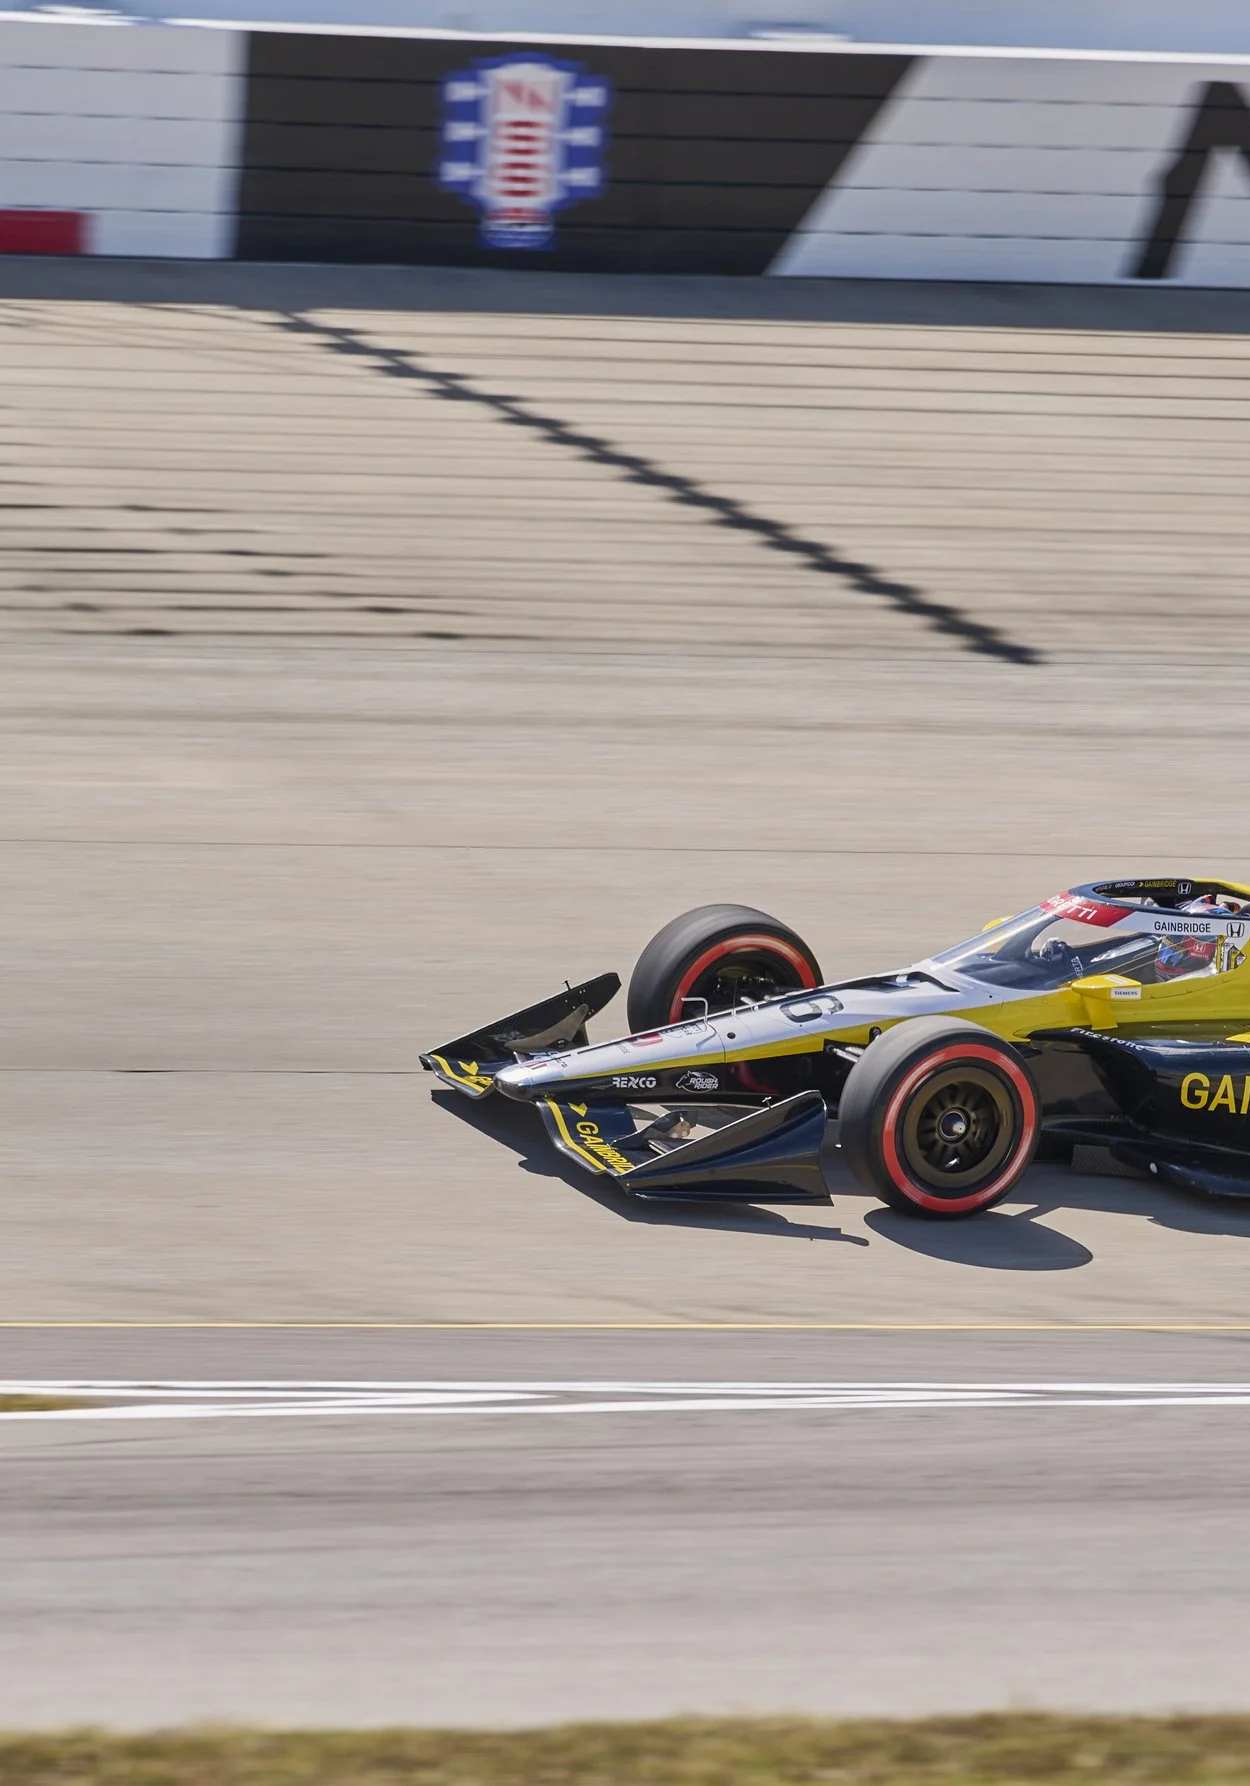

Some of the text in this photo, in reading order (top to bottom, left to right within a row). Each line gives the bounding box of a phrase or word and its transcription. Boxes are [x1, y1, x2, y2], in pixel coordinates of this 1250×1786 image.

[1144, 880, 1177, 888] GAINBRIDGE
[1154, 921, 1211, 933] GAINBRIDGE
[612, 1076, 657, 1089] REXCO
[690, 1077, 719, 1085] ROUGH
